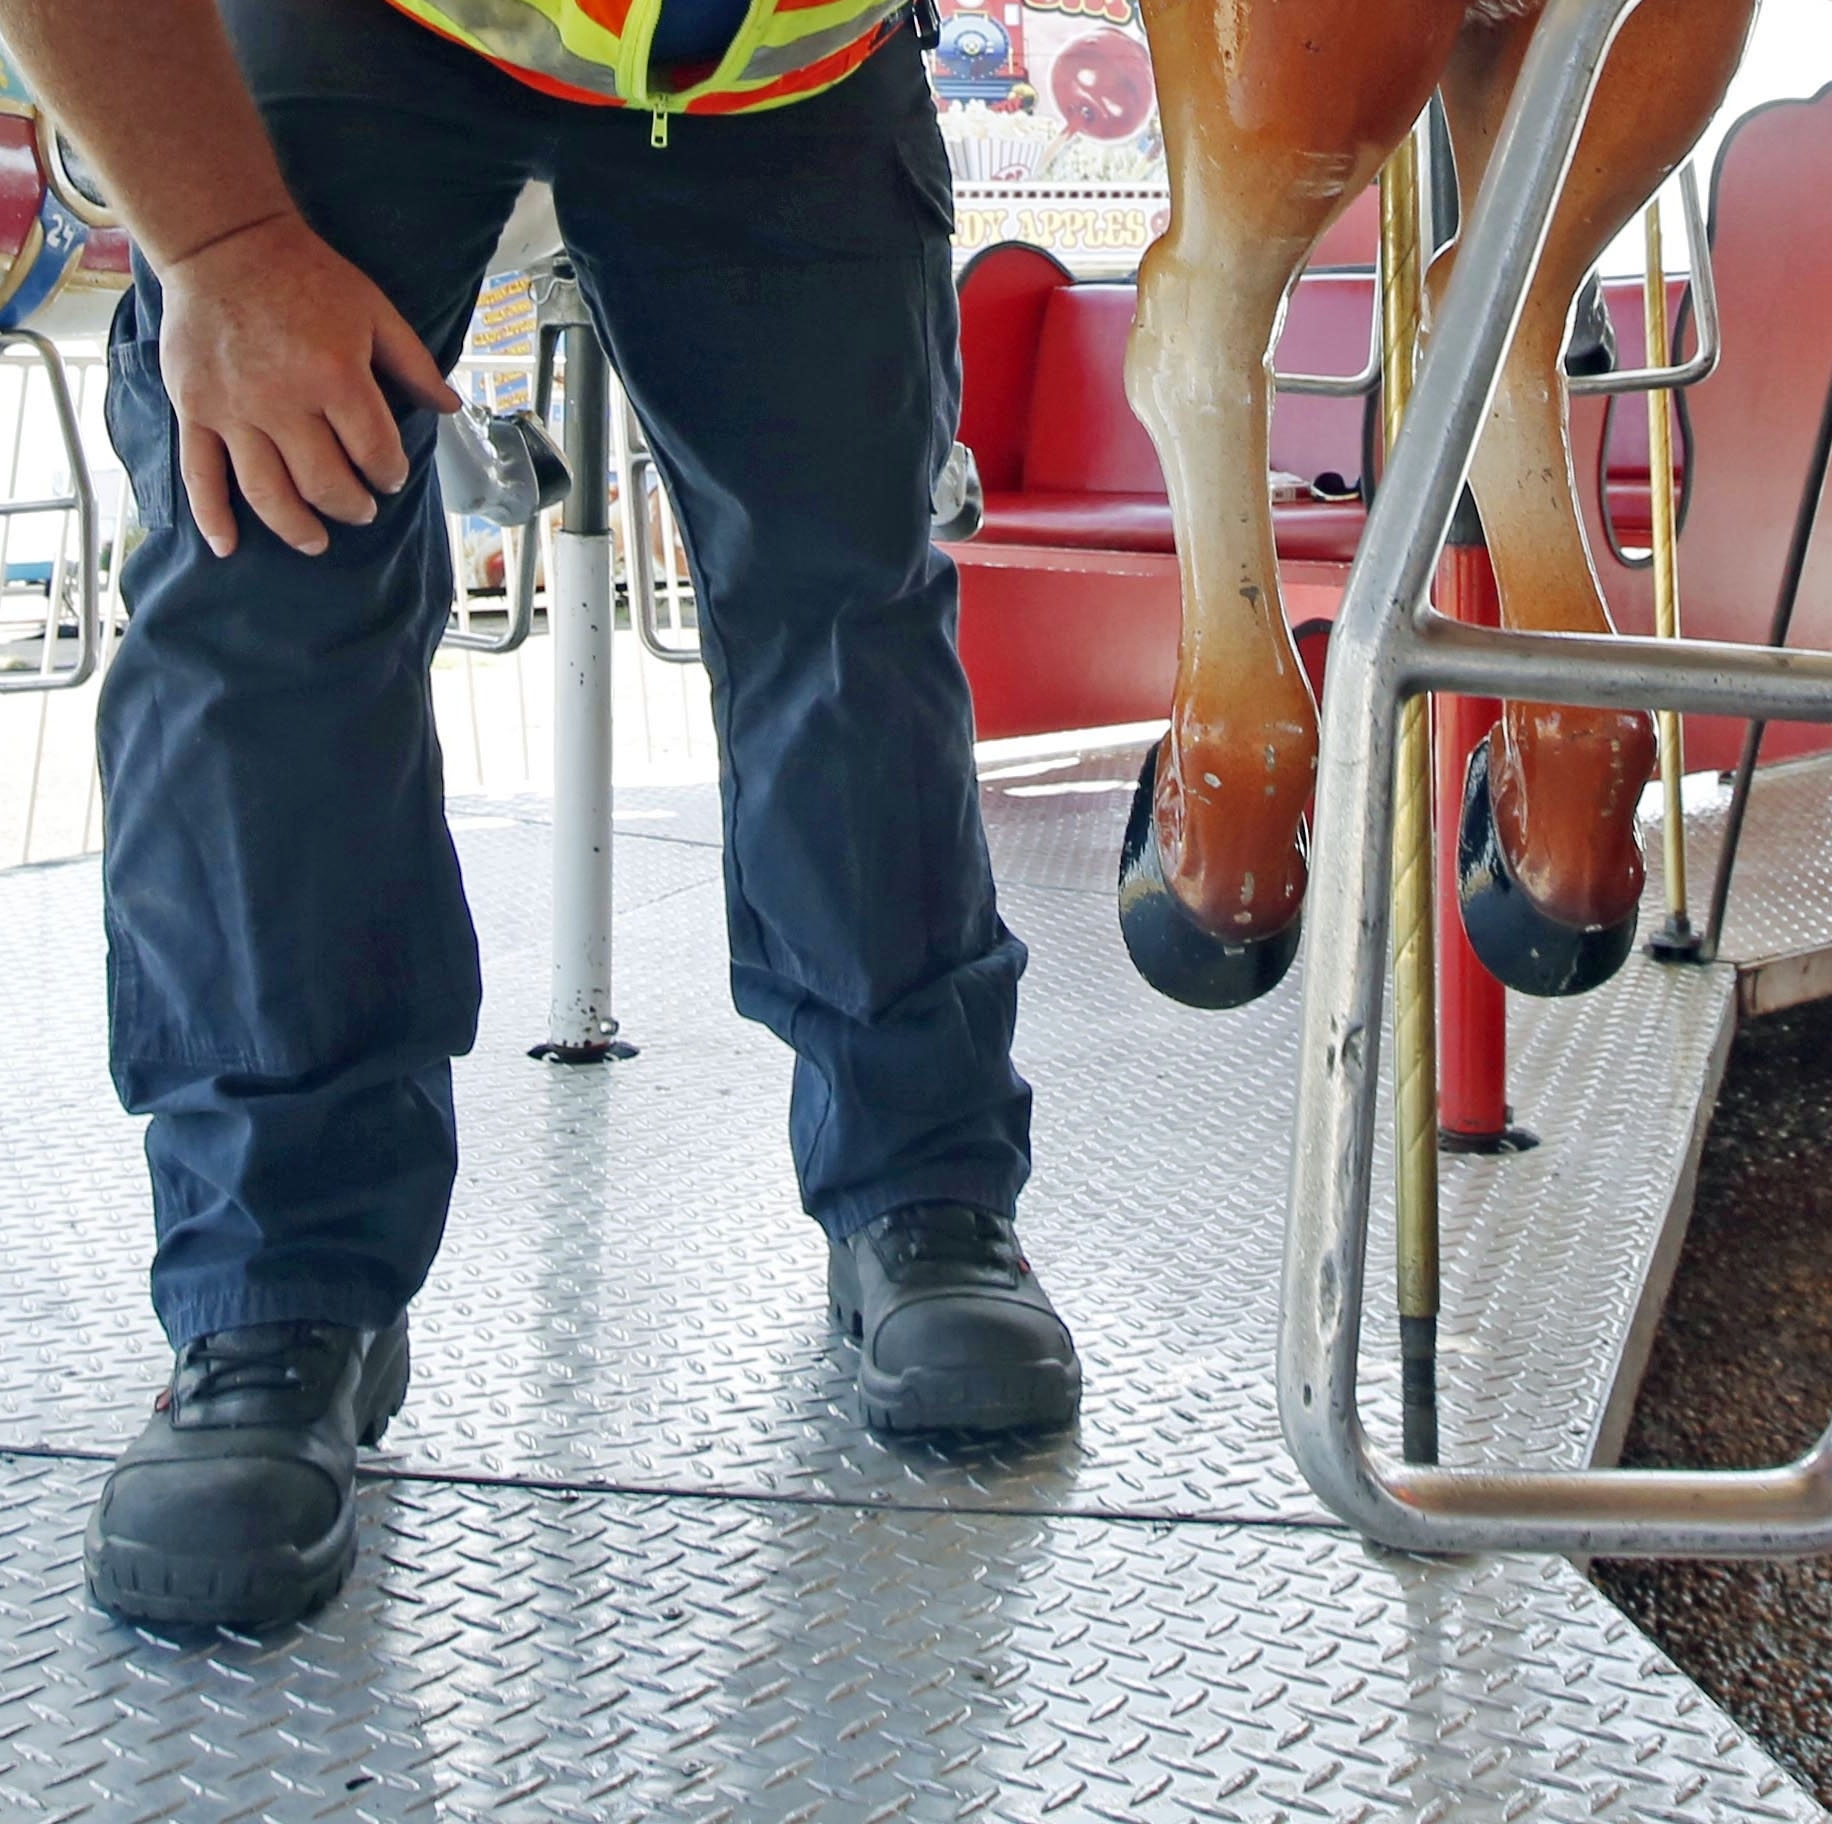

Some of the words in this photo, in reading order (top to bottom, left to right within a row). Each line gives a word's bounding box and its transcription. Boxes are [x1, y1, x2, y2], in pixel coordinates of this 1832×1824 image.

[46, 213, 75, 254] 24
[951, 209, 1009, 249] DY
[1017, 207, 1147, 249] APPLES
